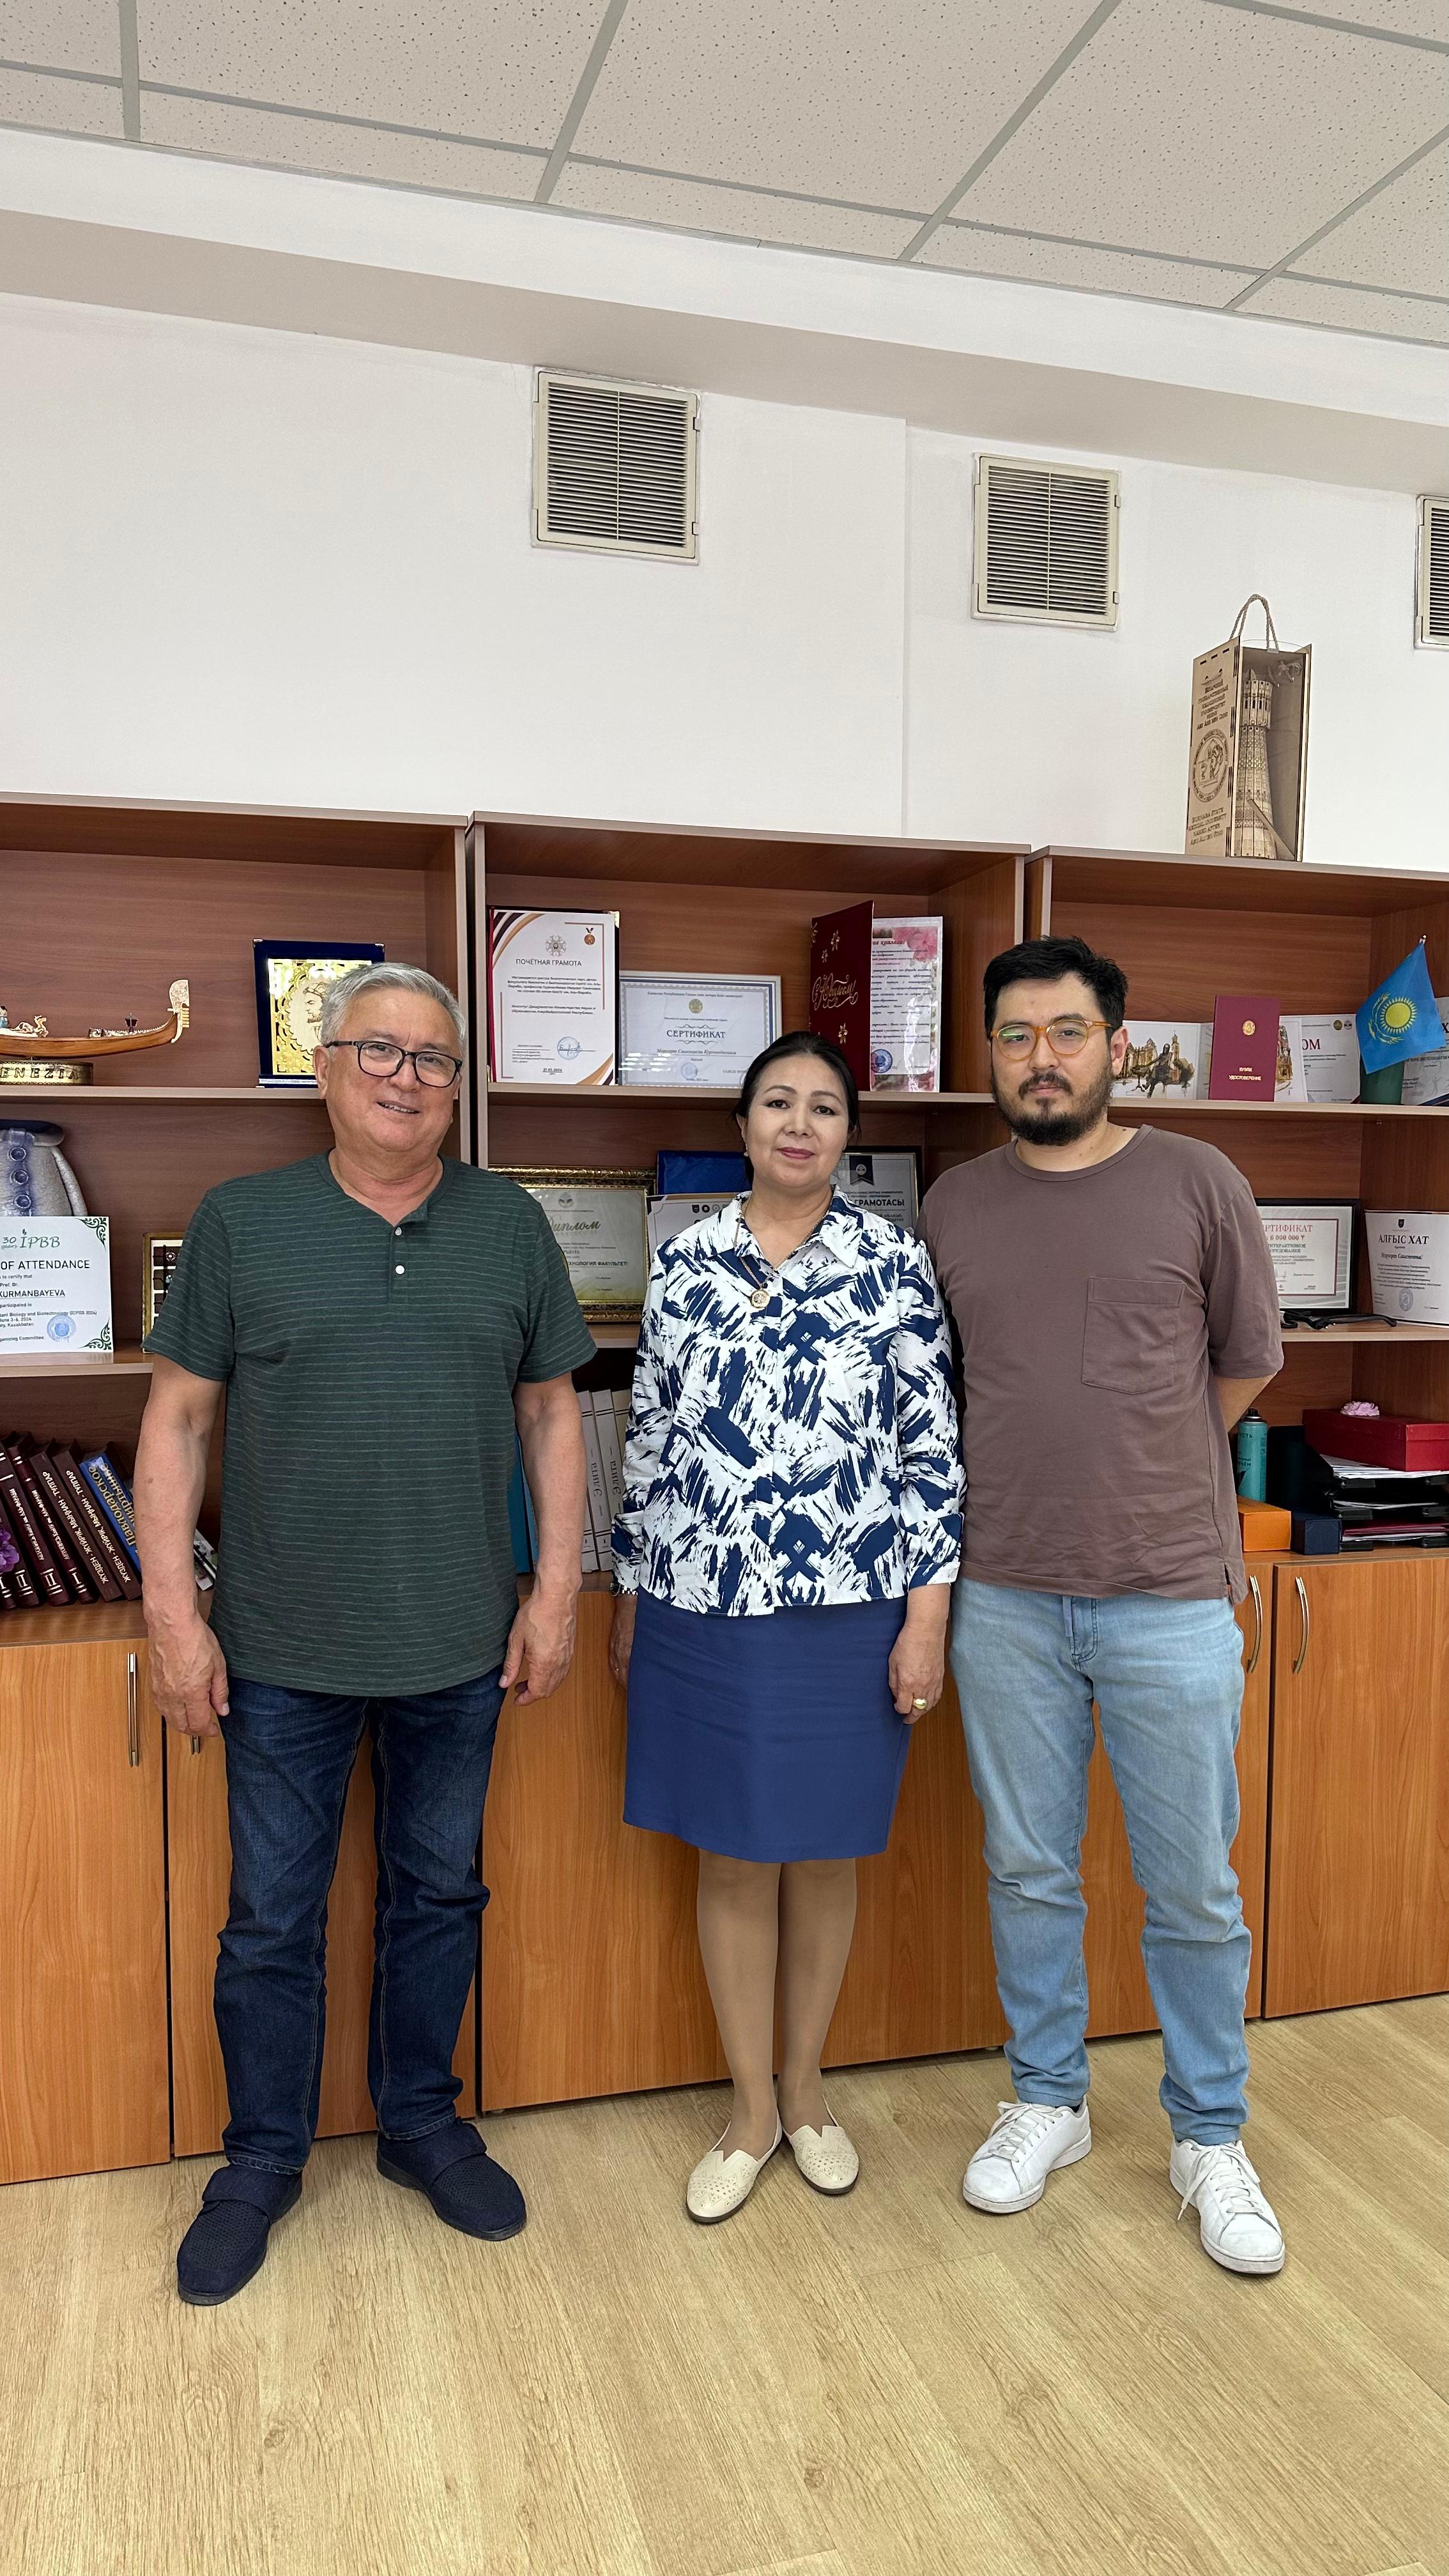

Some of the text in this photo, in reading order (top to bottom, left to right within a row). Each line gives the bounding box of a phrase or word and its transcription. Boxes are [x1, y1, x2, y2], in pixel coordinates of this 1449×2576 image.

[667, 1030, 726, 1038] СЕРТИФИКАТ
[0, 1067, 79, 1079] ENEZIA
[1408, 1236, 1429, 1244] ХАТ
[1, 1260, 90, 1269] OF ATTENDANCE
[590, 1462, 602, 1497] Элита
[610, 1460, 621, 1496] Элита
[89, 1466, 135, 1546] Павлодарское
